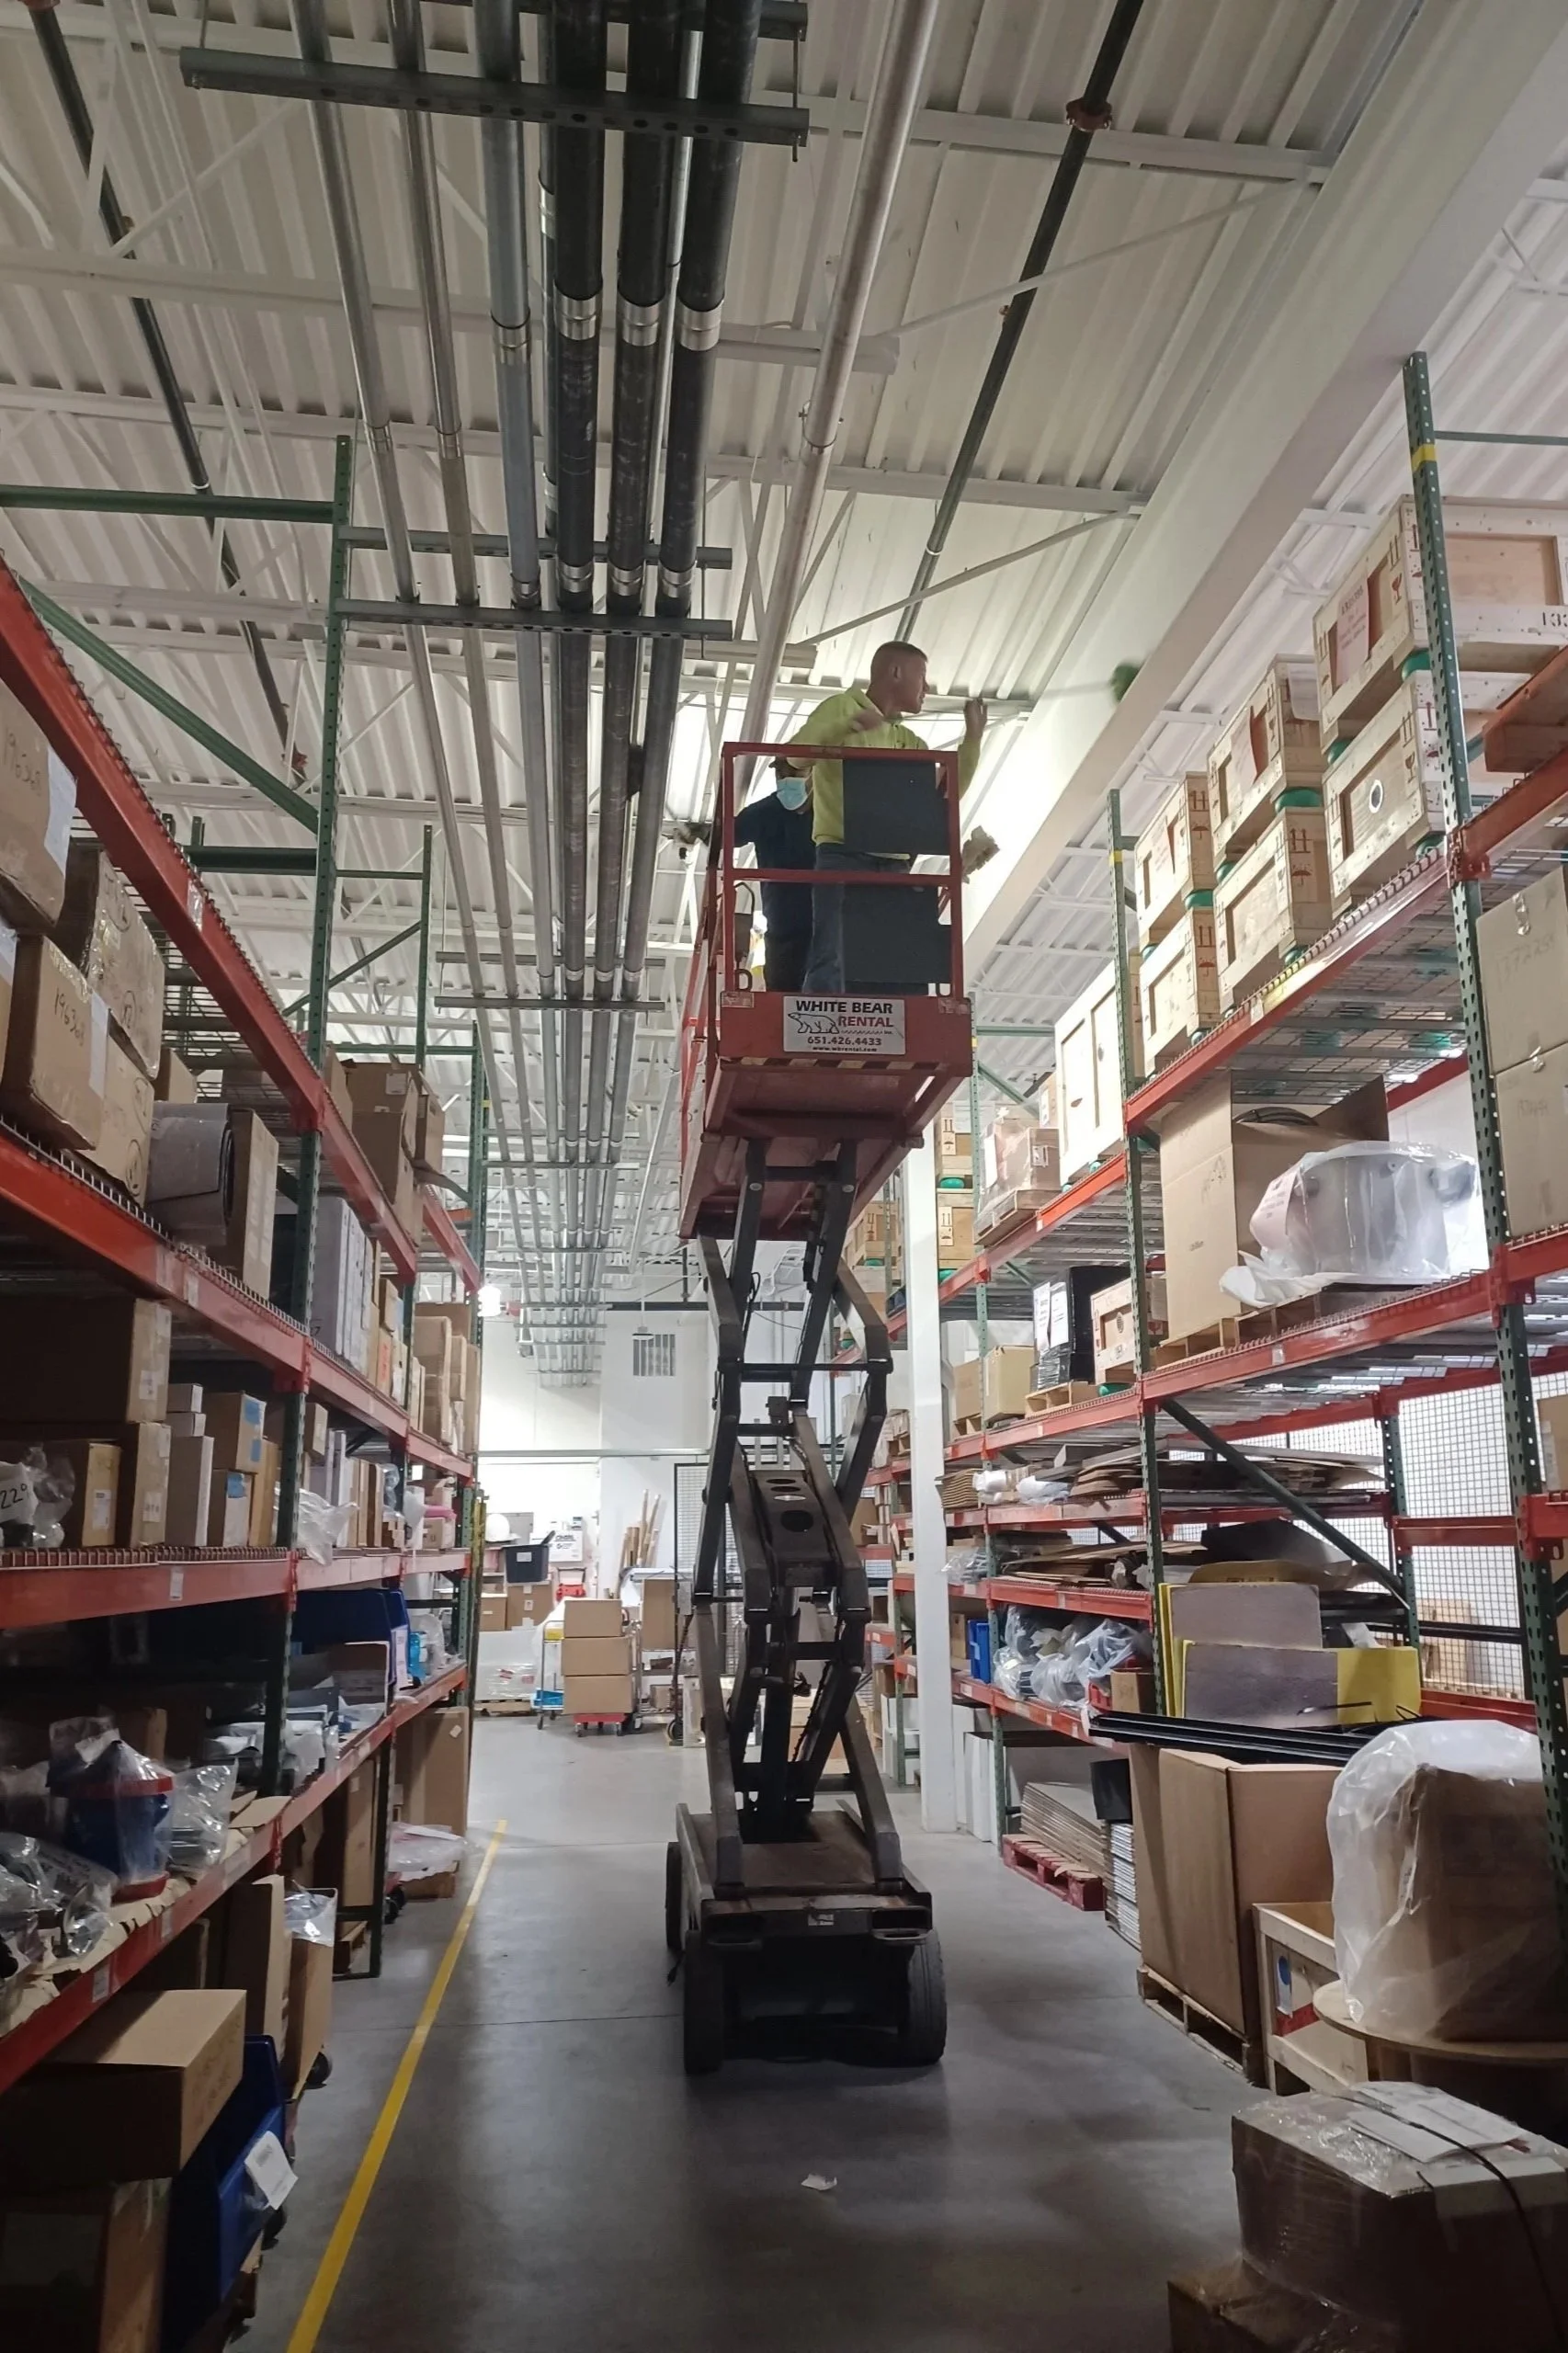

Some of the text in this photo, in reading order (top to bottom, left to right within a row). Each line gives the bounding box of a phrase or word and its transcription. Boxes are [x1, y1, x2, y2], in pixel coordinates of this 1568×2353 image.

[796, 1000, 893, 1014] WHITE BEAR
[837, 1016, 894, 1028] RENTAL
[807, 1036, 882, 1046] 651.426.4433
